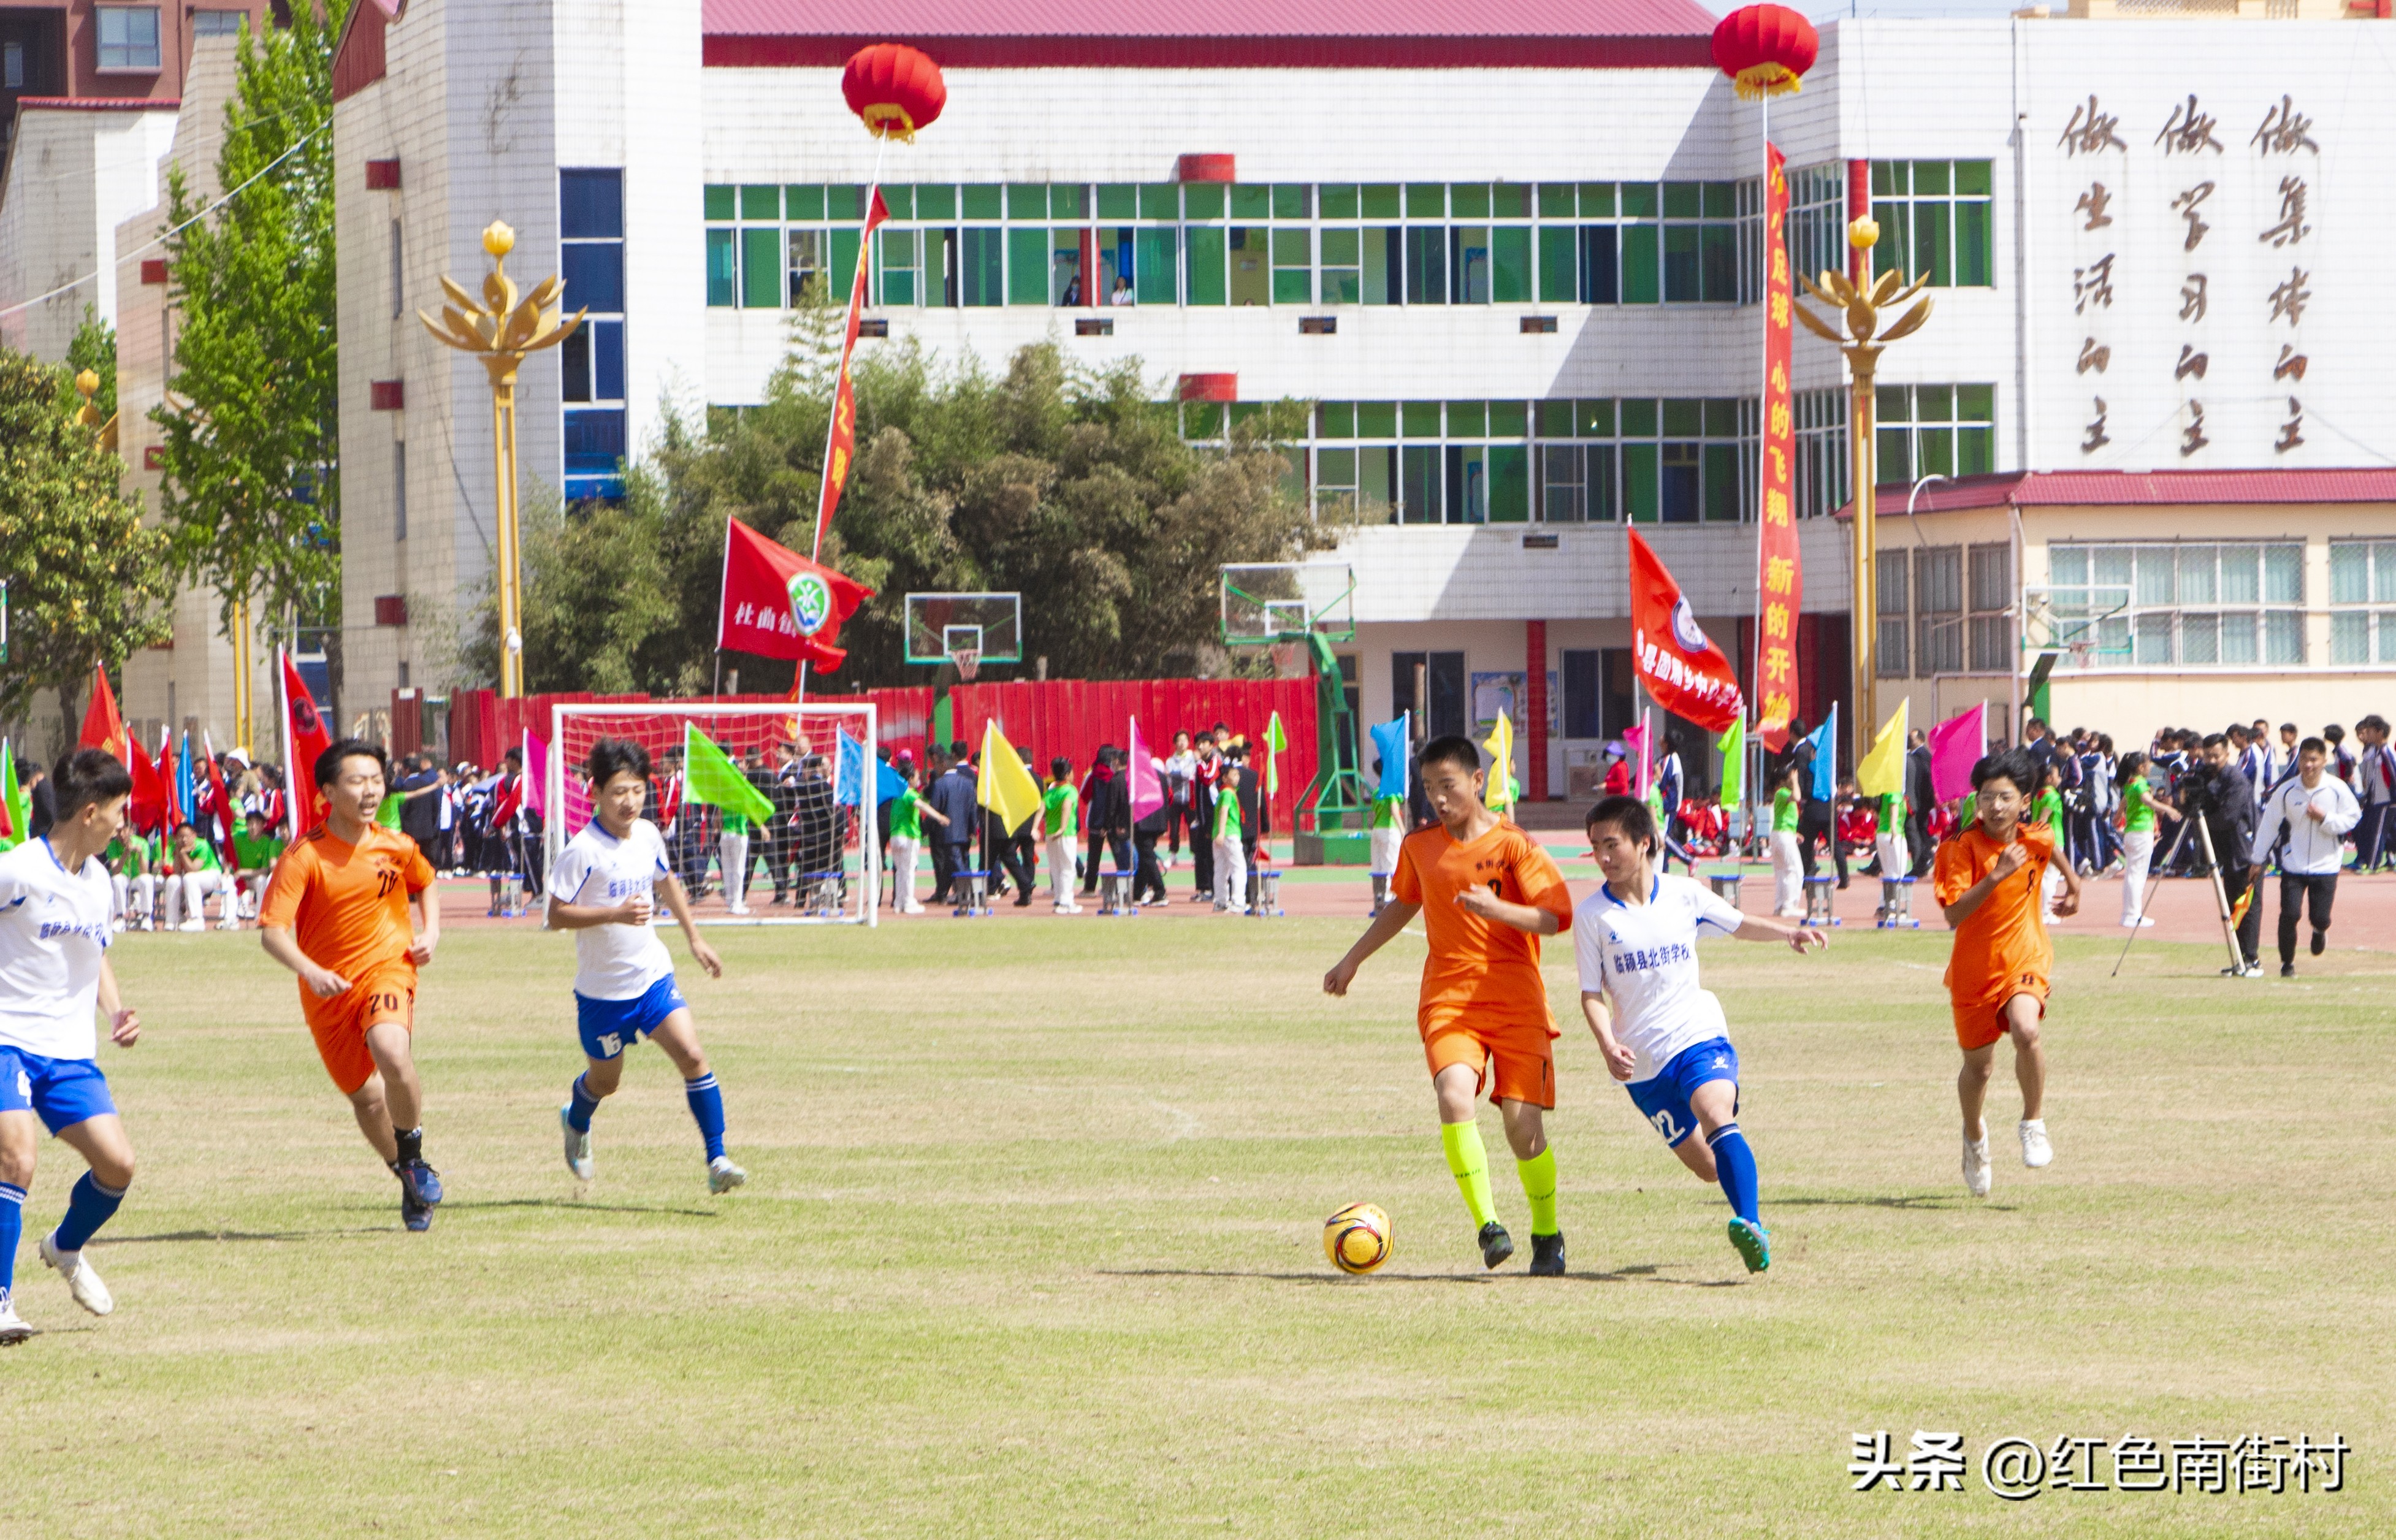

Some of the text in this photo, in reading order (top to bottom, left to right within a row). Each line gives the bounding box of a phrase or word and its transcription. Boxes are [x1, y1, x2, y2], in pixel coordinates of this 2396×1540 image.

[1766, 359, 1790, 528] 心的飞翔
[1764, 555, 1794, 730] 新的开始
[369, 994, 398, 1015] 20
[597, 1032, 622, 1058] 16
